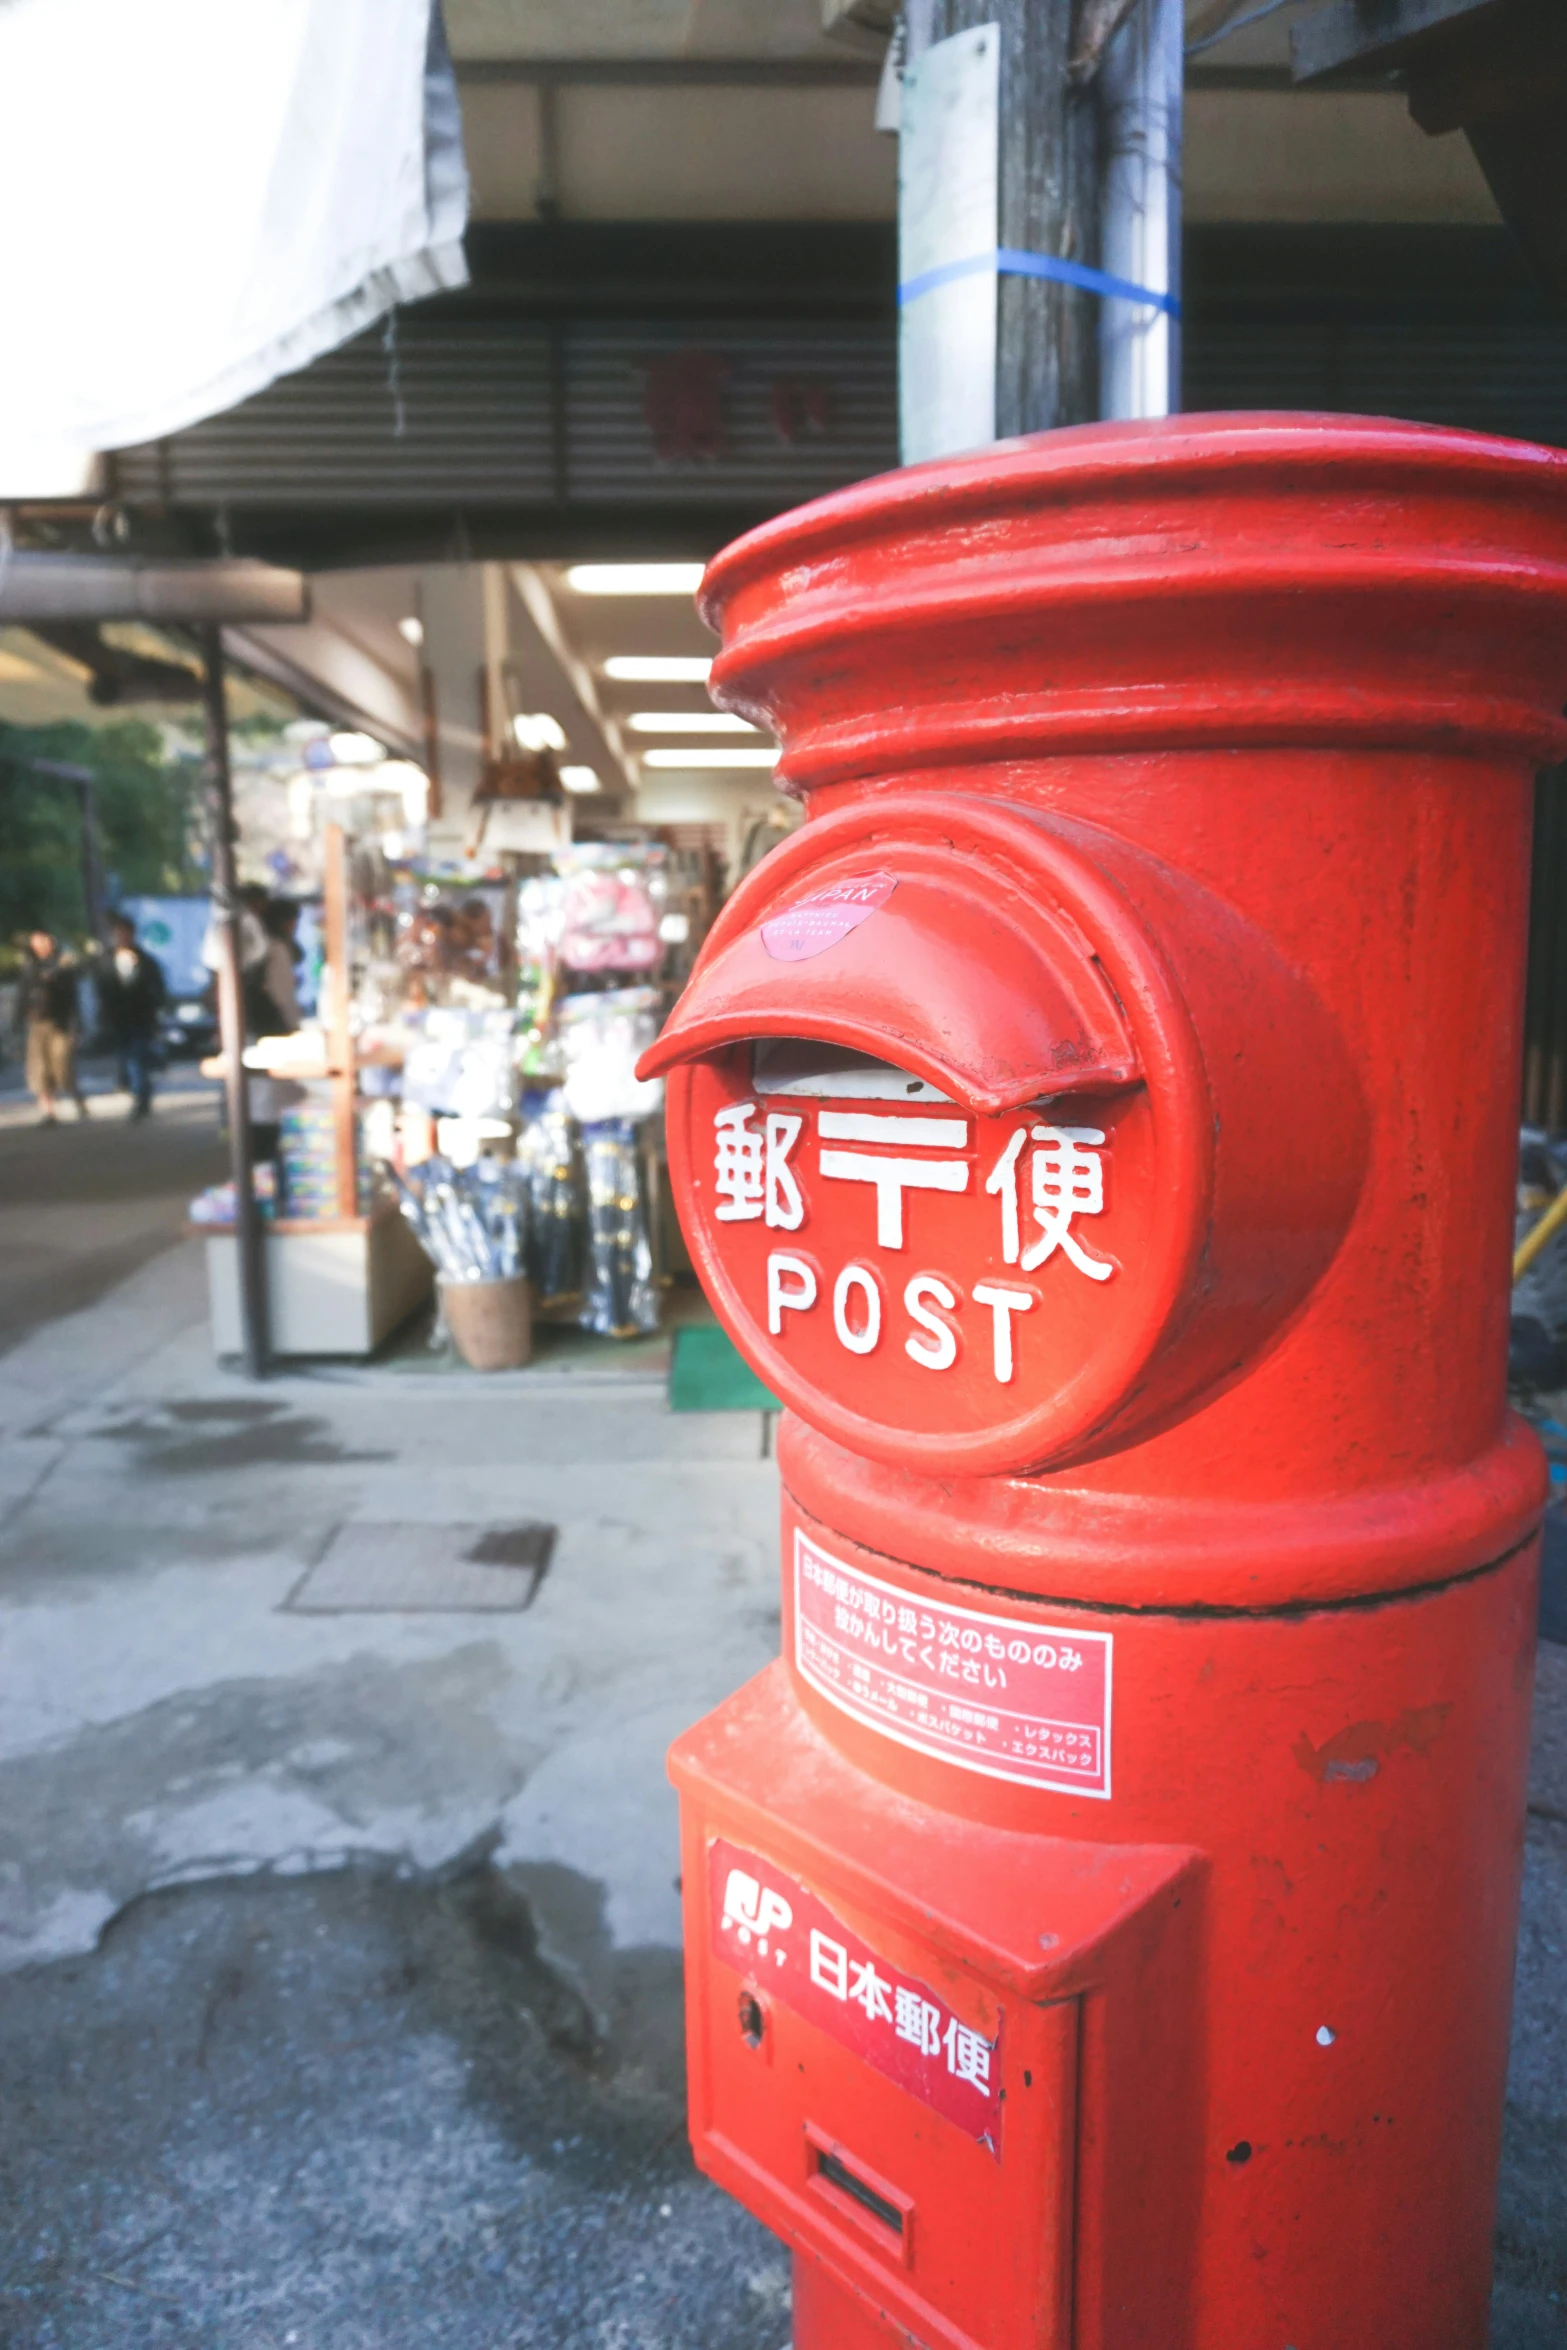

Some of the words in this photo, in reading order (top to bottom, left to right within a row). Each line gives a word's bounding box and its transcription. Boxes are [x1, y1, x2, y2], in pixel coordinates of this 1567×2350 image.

[767, 1253, 1034, 1384] POST
[803, 1554, 1083, 1672] 日本郵便が取り扱う次のもののみ
[810, 1927, 990, 2097] 日本郵便
